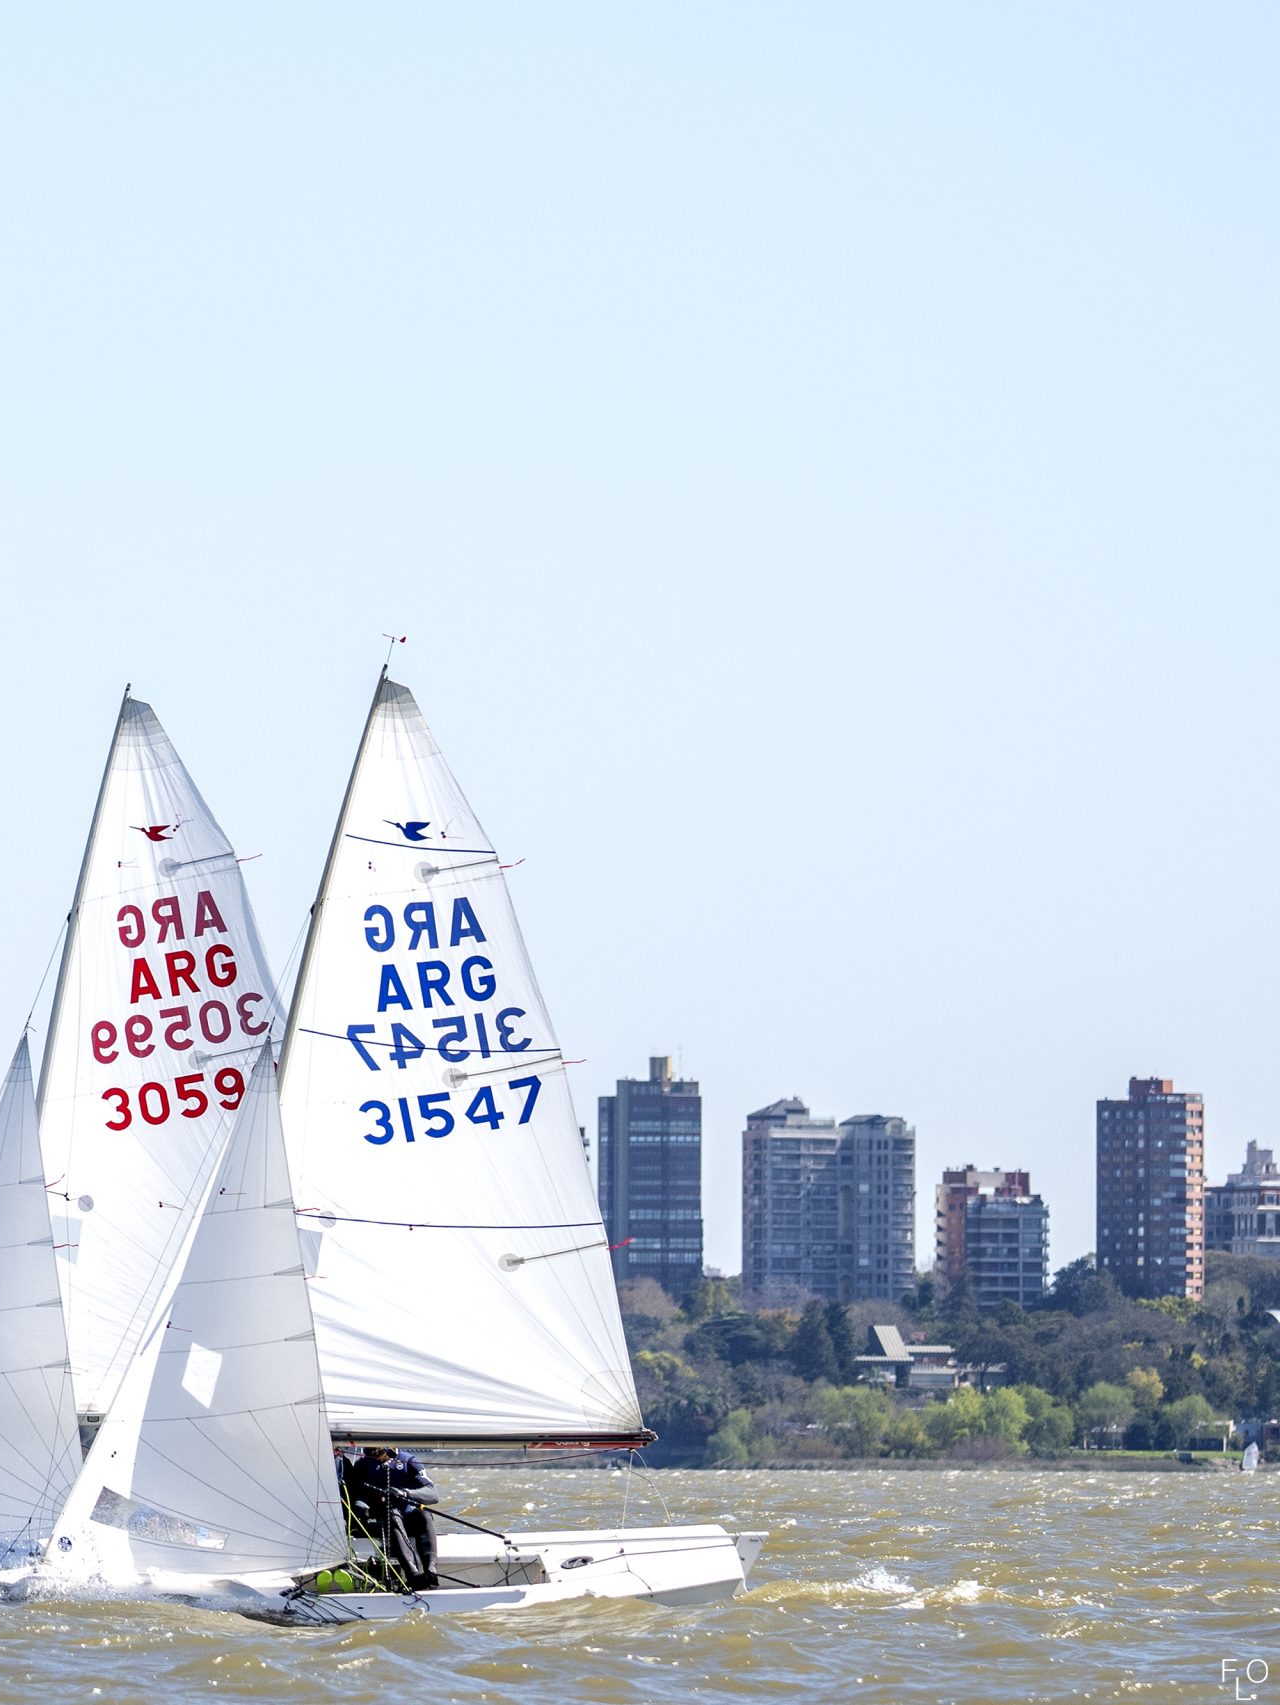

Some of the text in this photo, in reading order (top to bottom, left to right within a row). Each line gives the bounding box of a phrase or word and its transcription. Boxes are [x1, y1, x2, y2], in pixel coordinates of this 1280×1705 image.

[130, 944, 237, 1004] ARG
[377, 955, 497, 1012] ARG
[101, 1061, 278, 1131] 3059
[359, 1075, 542, 1146] 31547
